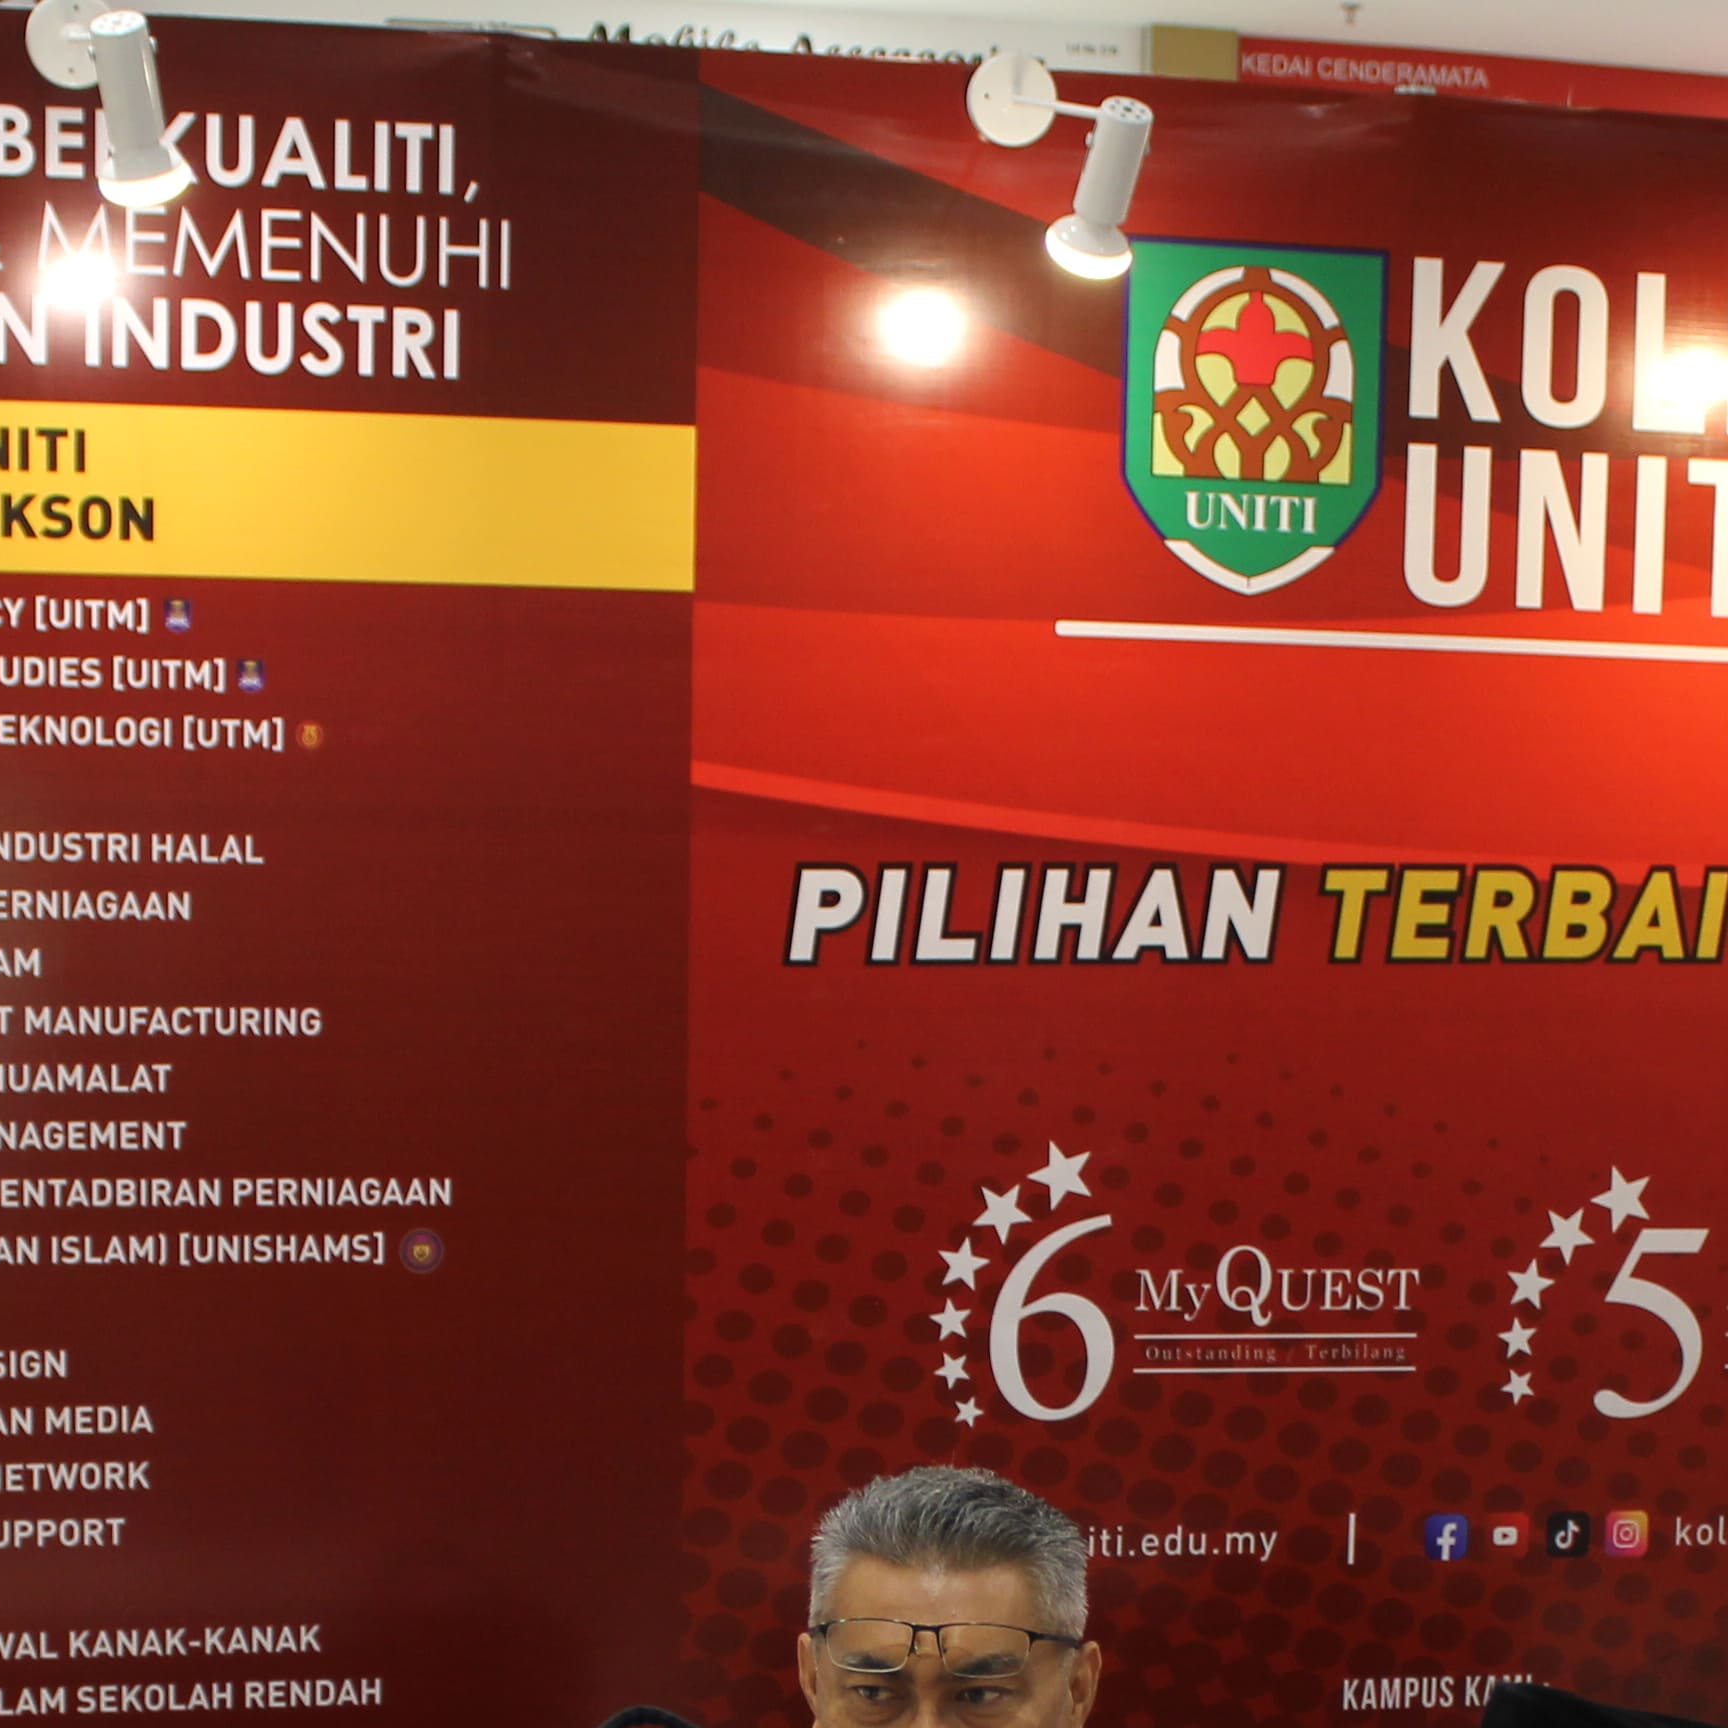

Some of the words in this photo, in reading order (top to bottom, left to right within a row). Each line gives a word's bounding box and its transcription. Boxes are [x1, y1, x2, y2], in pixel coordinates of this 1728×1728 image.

[1241, 52, 1311, 77] KEDAI
[37, 200, 512, 290] MEMENUHI
[82, 294, 461, 381] INDUSTRI
[1186, 491, 1315, 533] UNITI
[35, 595, 150, 634] [UITM]
[183, 715, 284, 753] [UTM]
[785, 861, 1284, 965] PILIHAN
[24, 1006, 322, 1036] MANUFACTURING
[233, 1177, 451, 1207] PERNIAGAAN
[51, 1233, 168, 1266] ISLAM)
[179, 1231, 385, 1267] [UNISHAMS]
[988, 1213, 1115, 1421] 6
[1593, 1228, 1709, 1419] 5
[1145, 1342, 1277, 1364] Outstanding
[1303, 1341, 1407, 1363] Terbilang
[45, 1405, 154, 1435] MEDIA
[1086, 1520, 1279, 1565] iti.edu.my
[69, 1624, 321, 1659] KANAK-KANAK
[1342, 1675, 1455, 1711] KAMPUS
